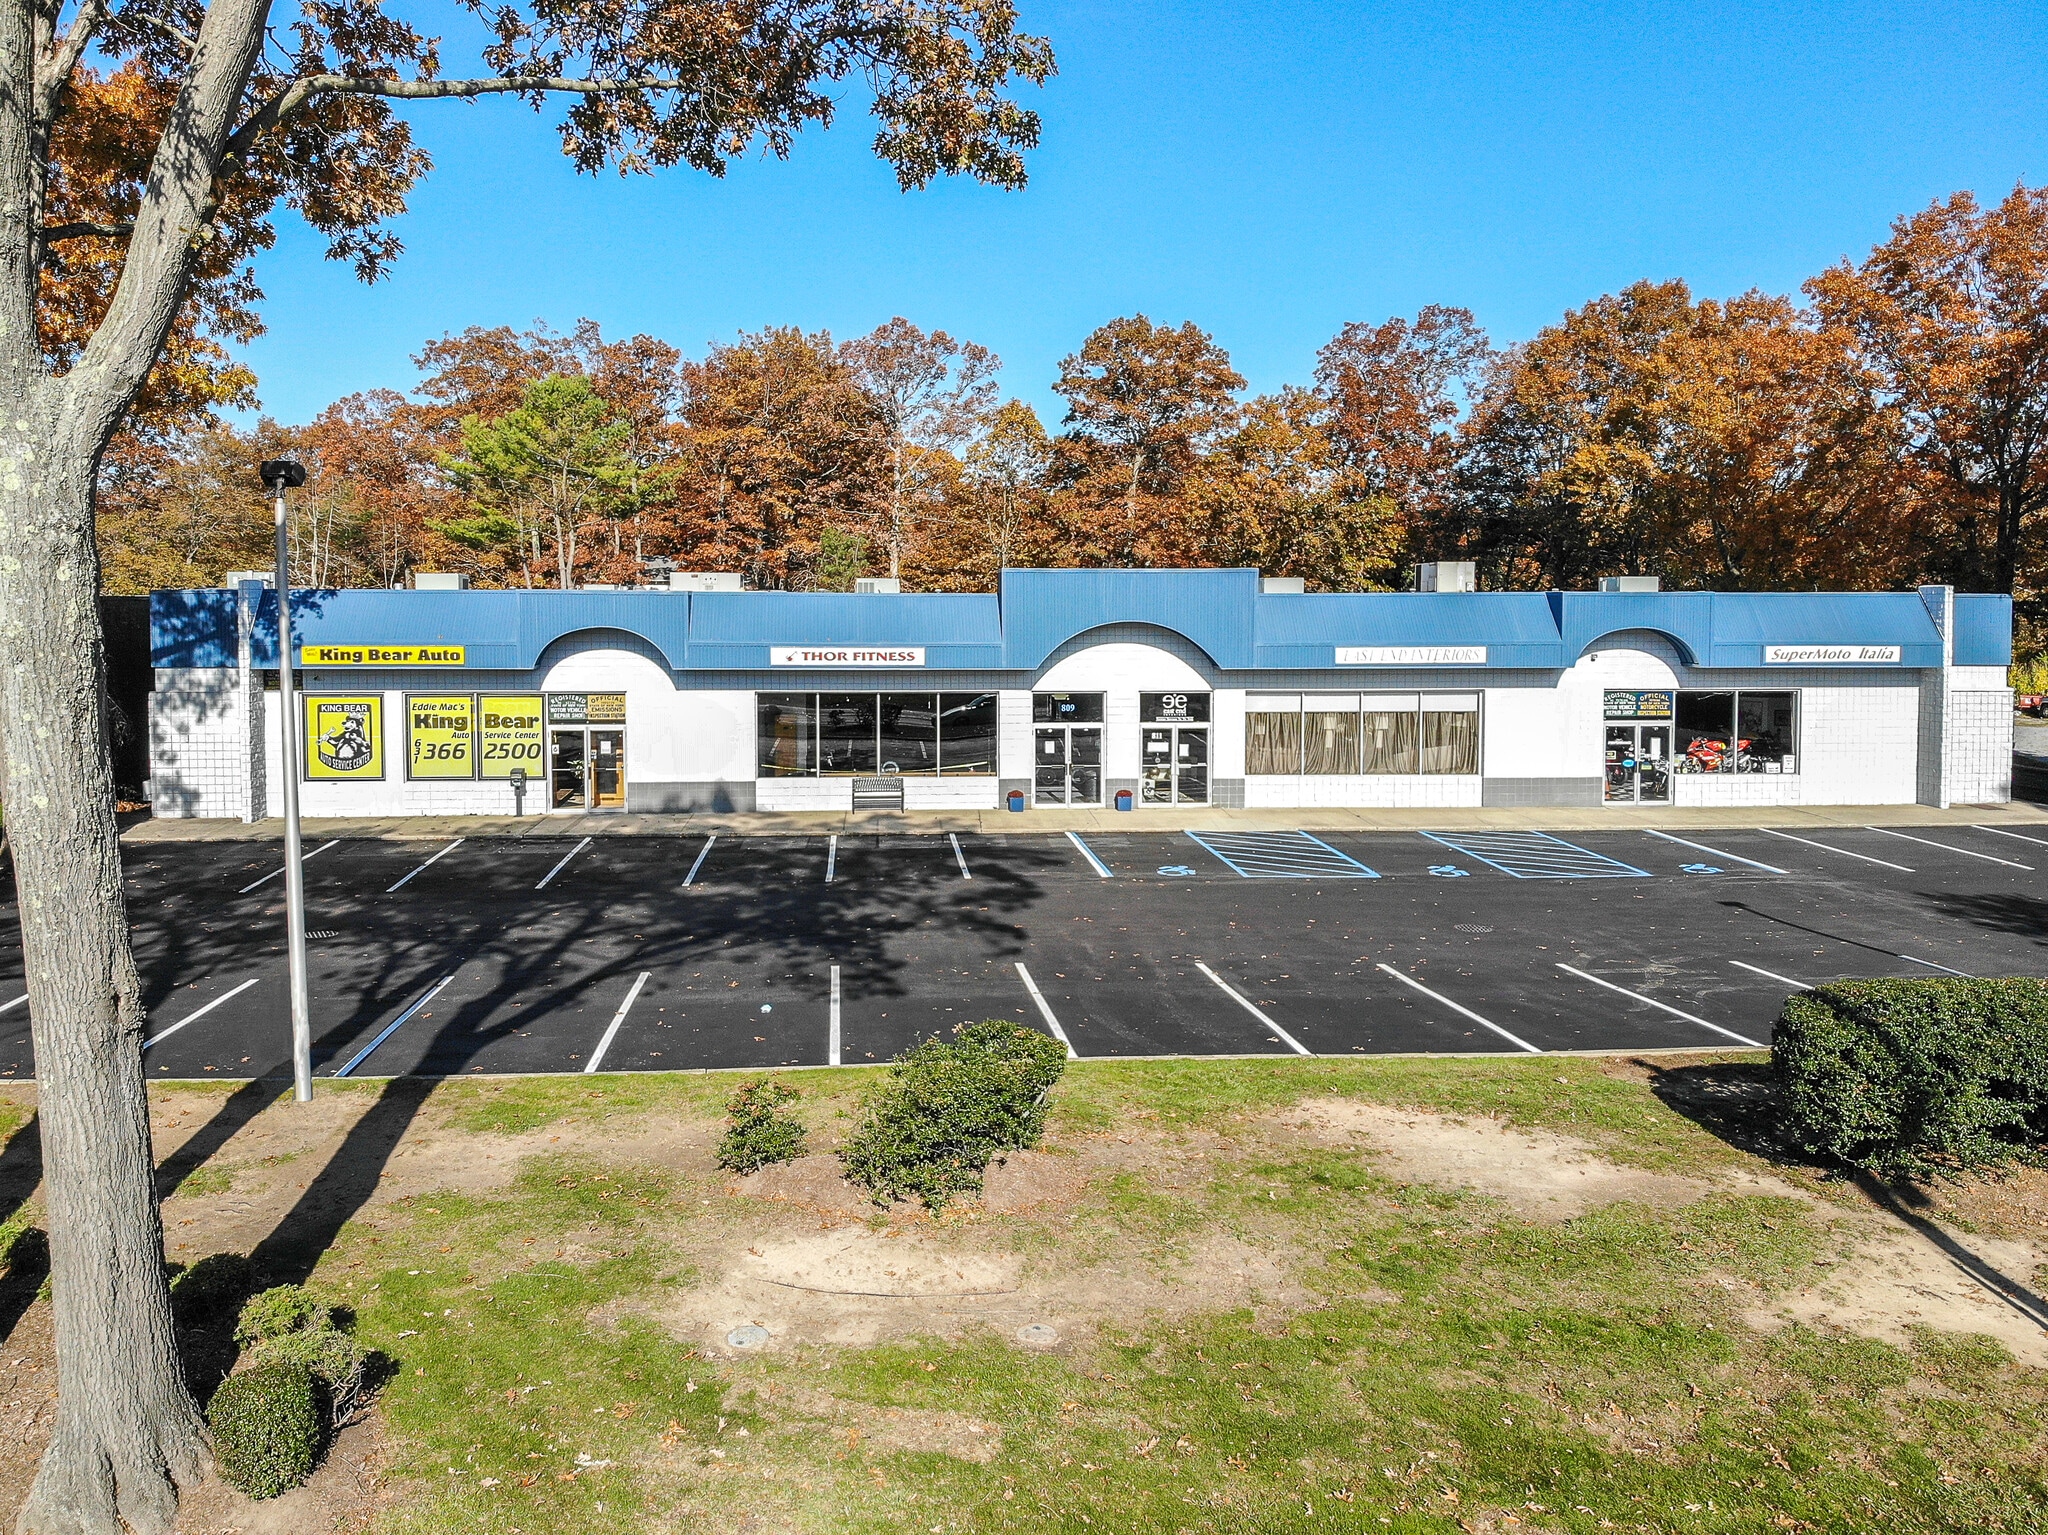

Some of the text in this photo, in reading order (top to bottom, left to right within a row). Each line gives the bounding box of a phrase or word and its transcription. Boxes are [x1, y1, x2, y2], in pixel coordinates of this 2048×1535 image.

[320, 648, 363, 663] King
[368, 649, 412, 661] Bear
[418, 649, 460, 661] Auto
[802, 651, 915, 661] THOR FITNESS
[1411, 648, 1480, 662] INTERIORS
[1771, 647, 1894, 662] SuperMoto Italia
[550, 694, 587, 704] REGISTERED
[590, 695, 624, 704] OFFICIAL
[1604, 692, 1636, 702] REGISTERED
[1639, 693, 1669, 701] OFFICIAL
[321, 704, 368, 712] KING BEAR
[412, 703, 465, 711] Eddie Mac's
[1061, 703, 1075, 712] 809
[414, 714, 540, 731] King Bear
[423, 743, 541, 759] 366 2500
[320, 752, 370, 770] AUTO SERVICE CENTER
